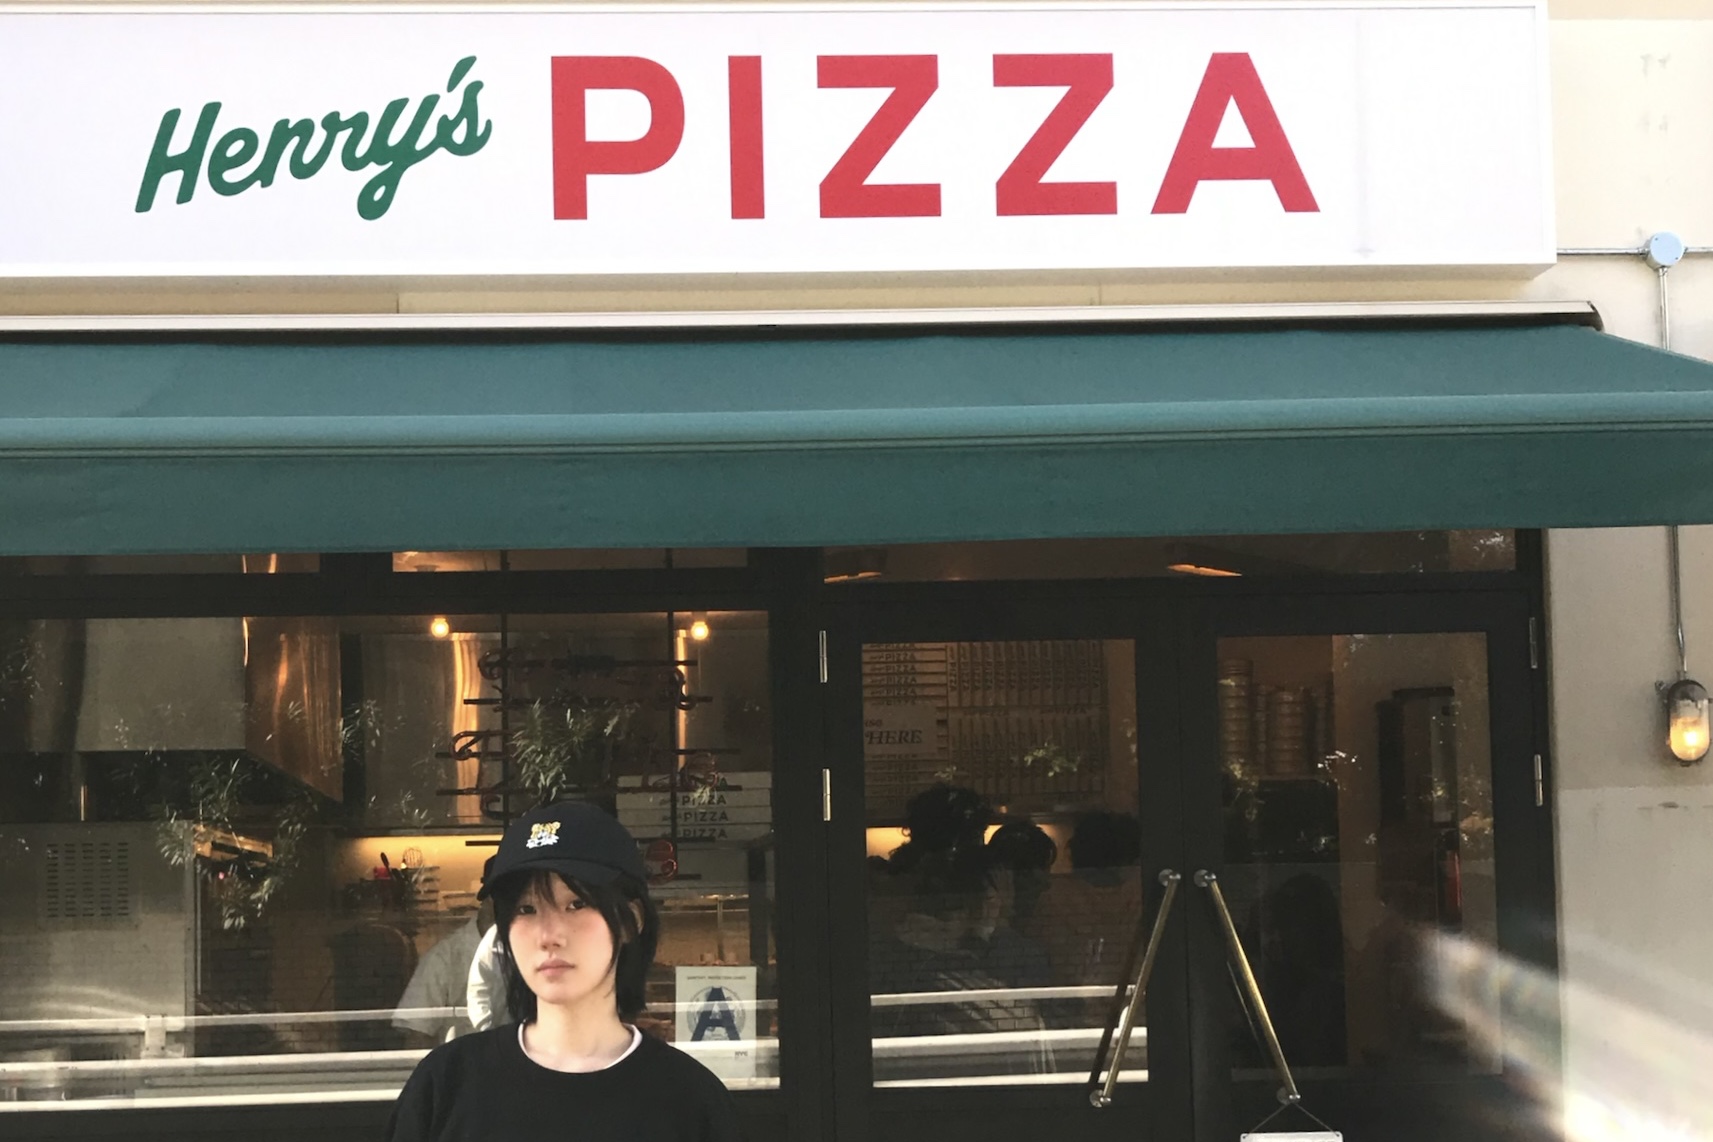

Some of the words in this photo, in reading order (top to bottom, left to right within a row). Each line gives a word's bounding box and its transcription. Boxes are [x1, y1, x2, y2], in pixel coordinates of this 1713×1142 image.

[137, 57, 491, 219] Henry's
[552, 53, 1319, 220] PIZZA
[885, 653, 916, 661] PIZZA
[865, 729, 922, 744] HERE
[684, 811, 729, 822] PIZZA
[683, 829, 728, 839] PIZZA
[690, 986, 742, 1042] A
